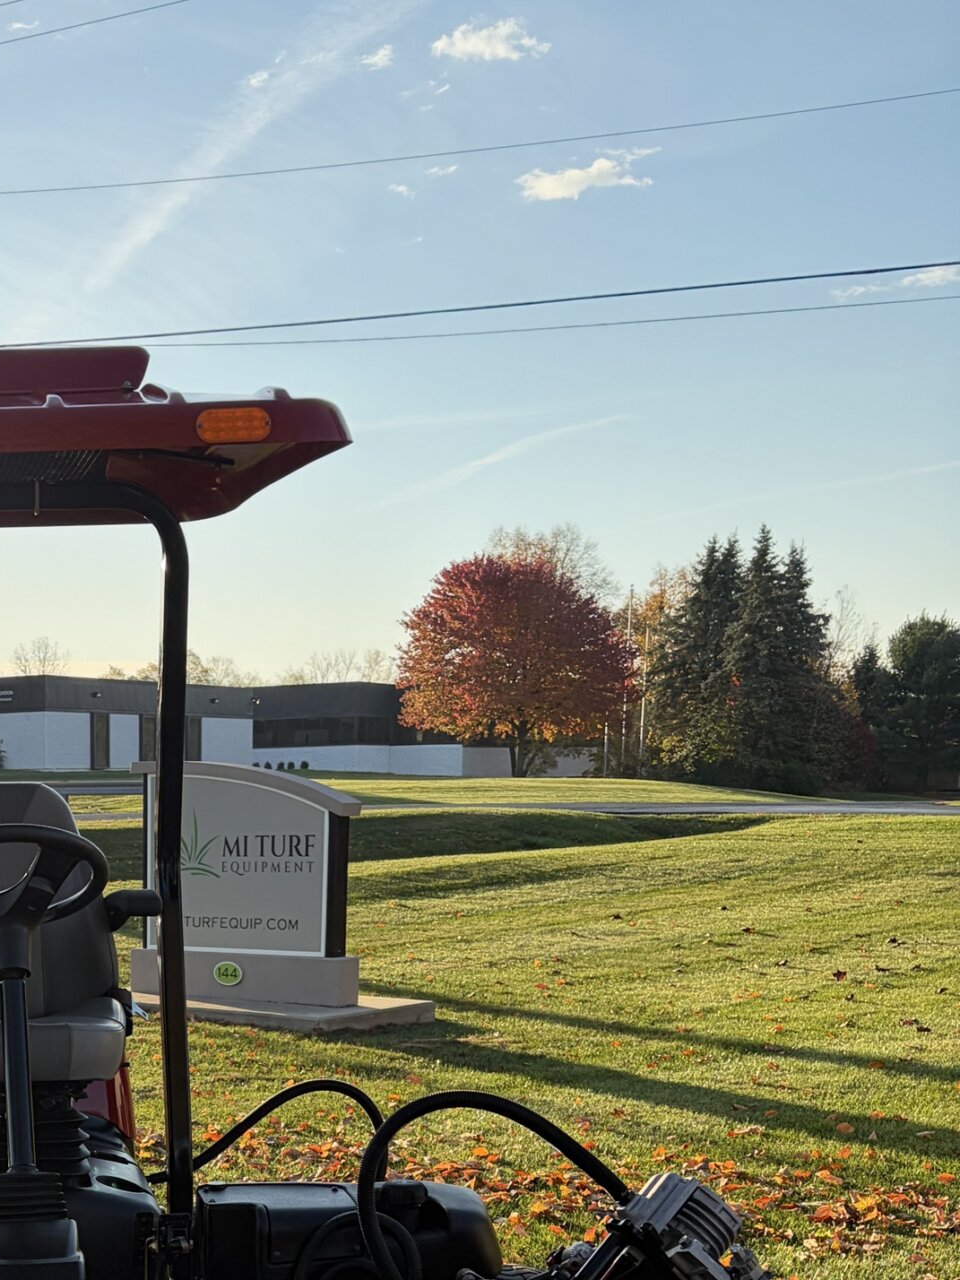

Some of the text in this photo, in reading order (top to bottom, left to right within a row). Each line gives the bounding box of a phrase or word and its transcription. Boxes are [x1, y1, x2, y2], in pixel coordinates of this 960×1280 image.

[222, 834, 316, 857] MI TURF
[221, 861, 315, 876] EQUIPMENT
[183, 916, 299, 931] TURFEQUIP.COM
[218, 967, 238, 979] 144
